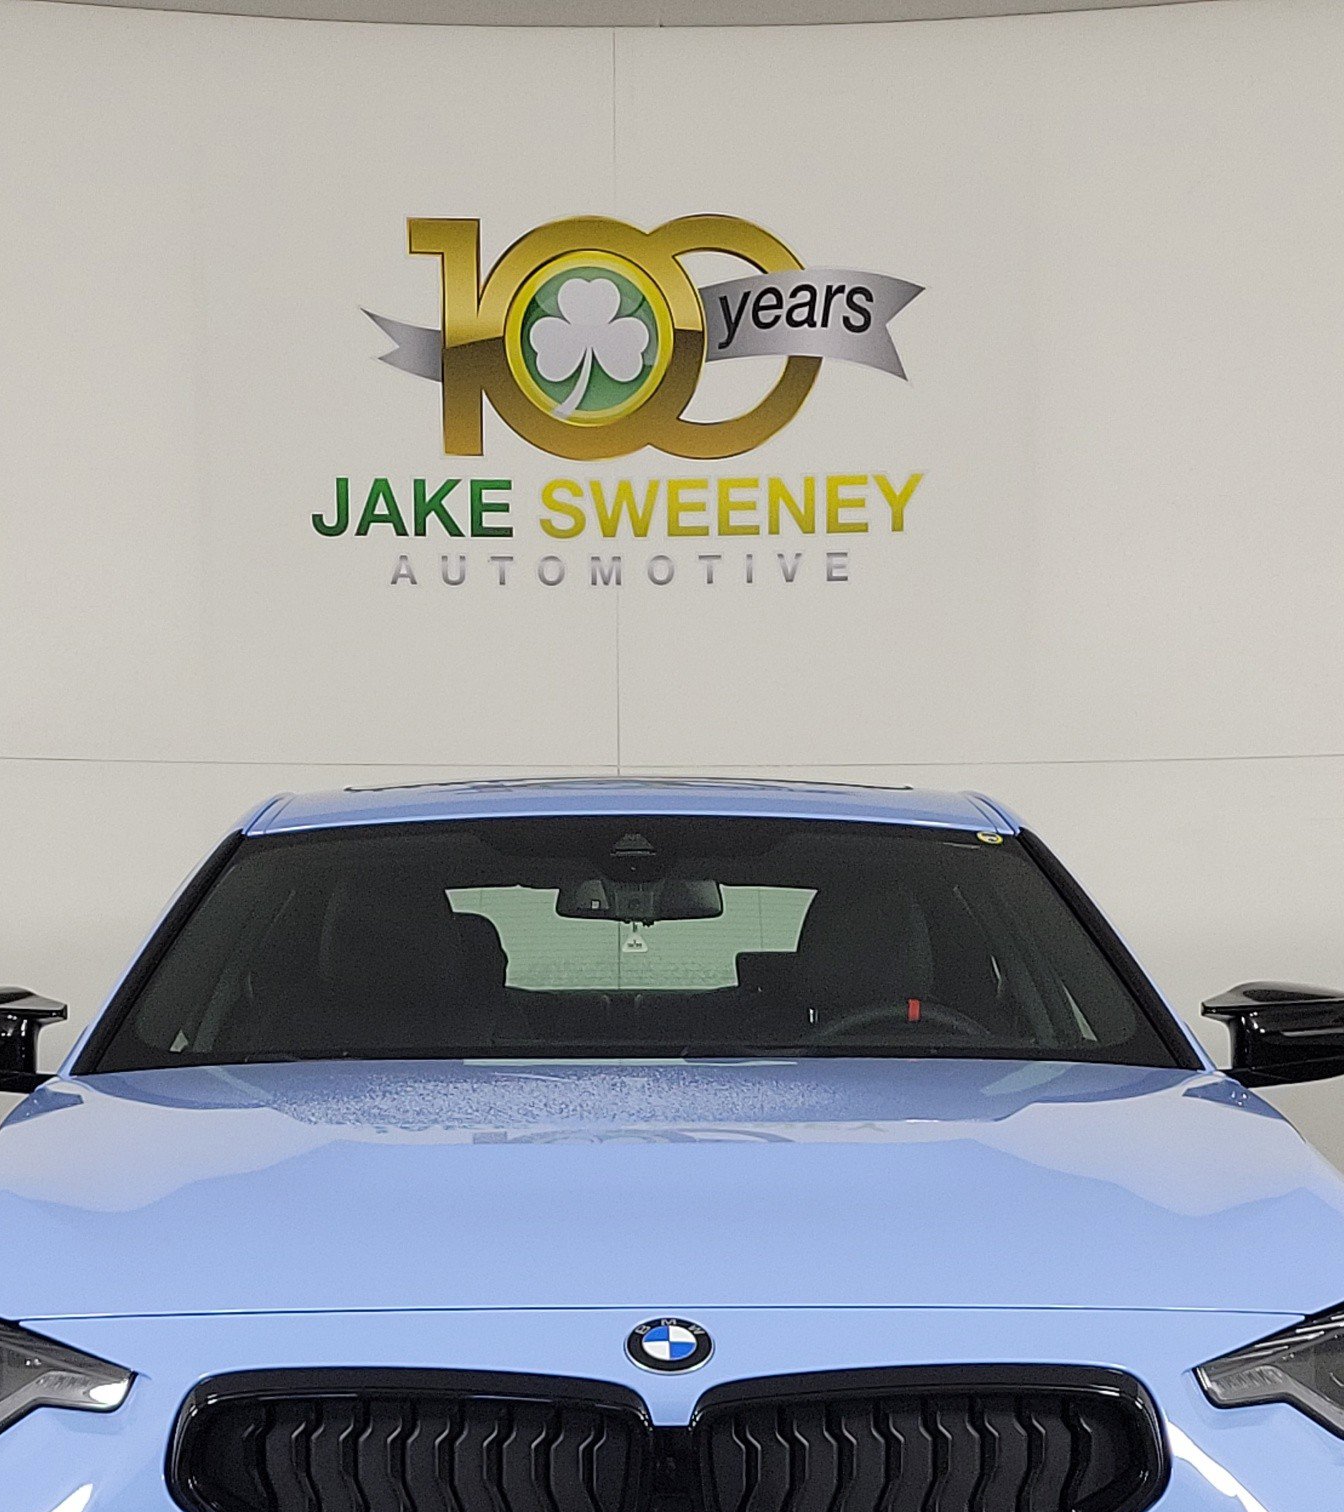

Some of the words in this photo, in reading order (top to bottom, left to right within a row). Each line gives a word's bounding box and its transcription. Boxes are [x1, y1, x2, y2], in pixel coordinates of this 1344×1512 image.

[407, 213, 824, 461] 100
[717, 282, 875, 350] years
[311, 477, 514, 538] JAKE
[538, 472, 925, 539] SWEENEY
[389, 551, 851, 587] AUTOMOTIVE
[635, 1318, 706, 1336] BMW
